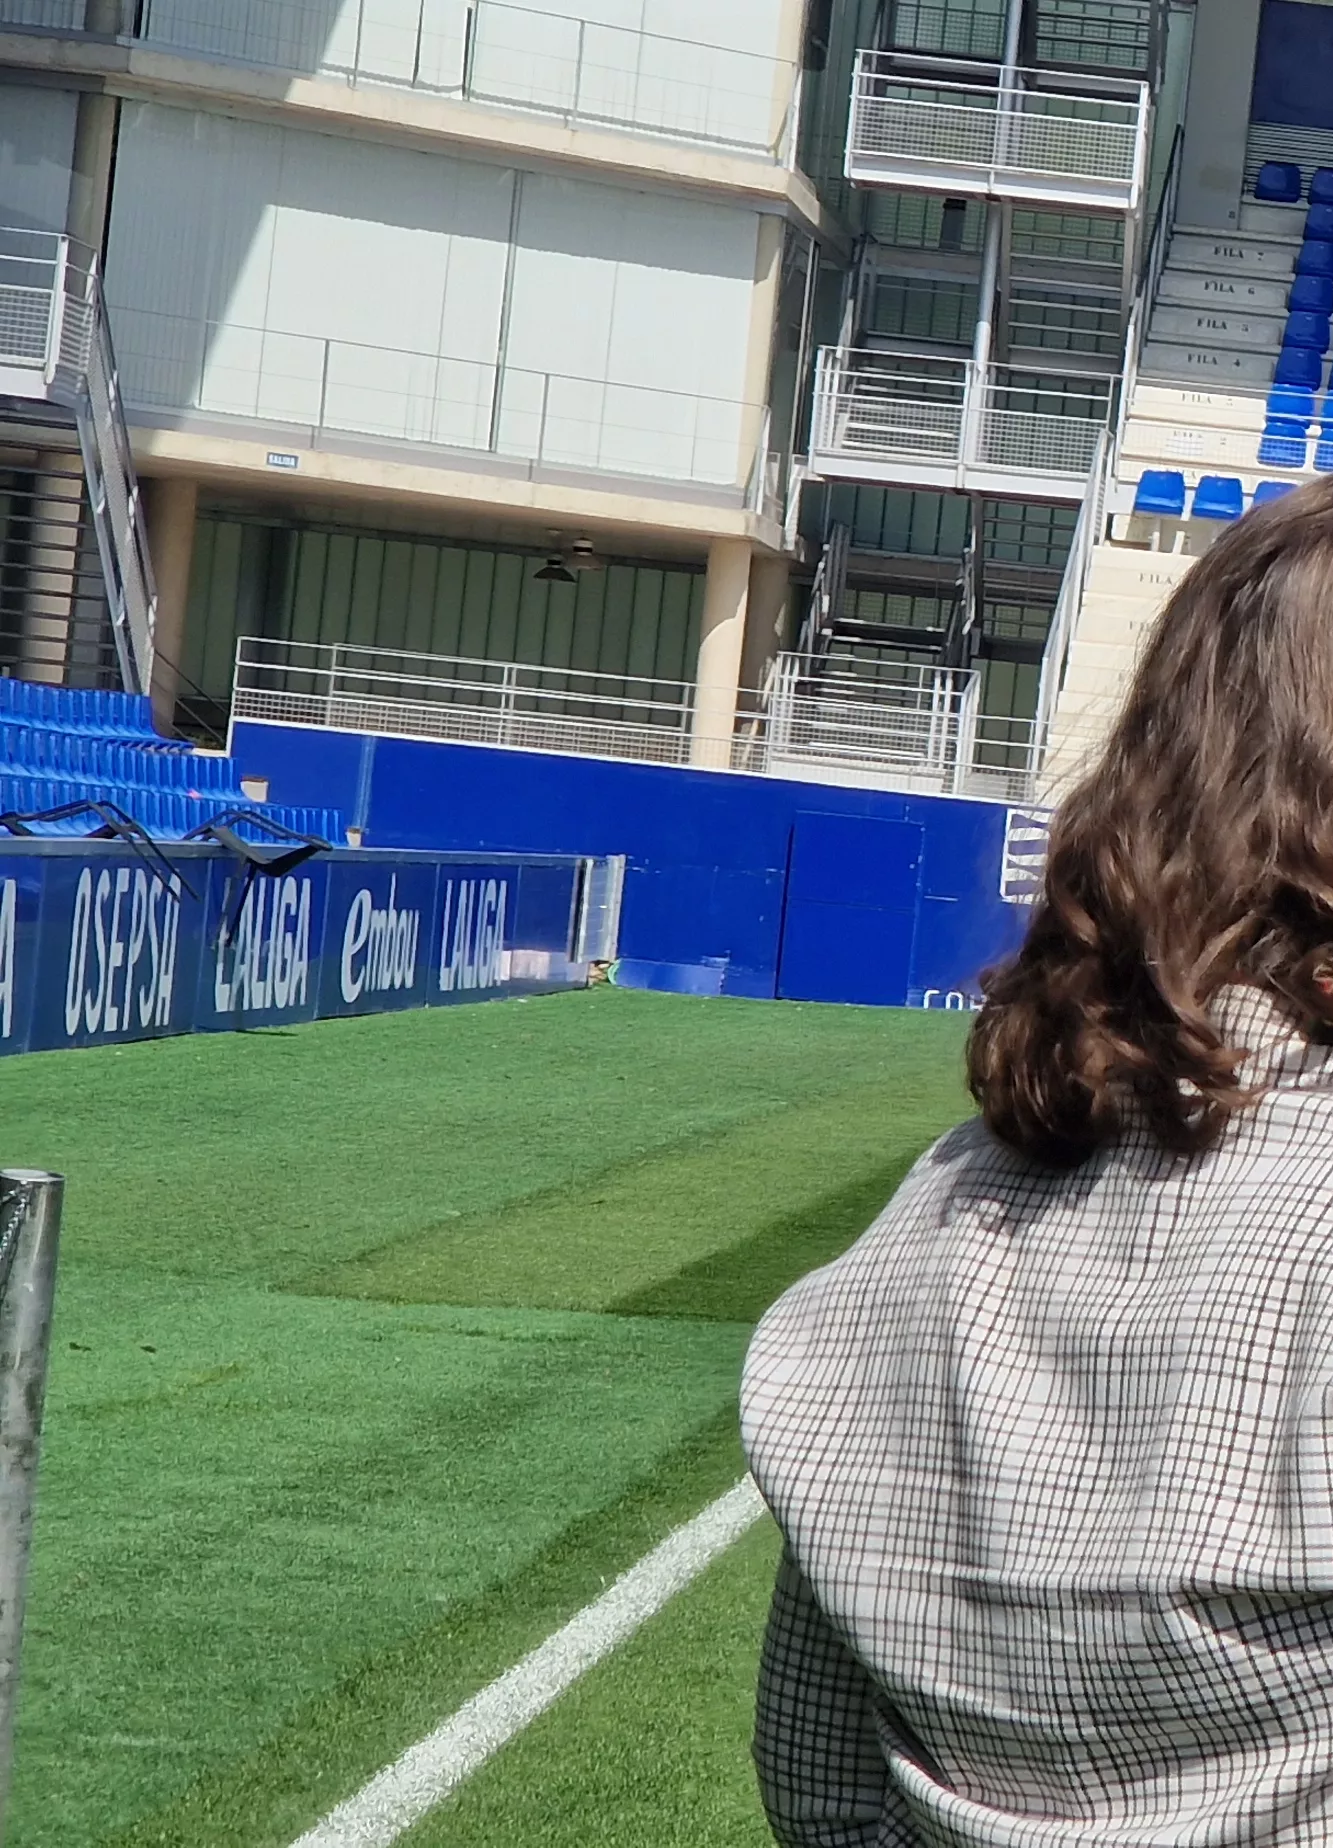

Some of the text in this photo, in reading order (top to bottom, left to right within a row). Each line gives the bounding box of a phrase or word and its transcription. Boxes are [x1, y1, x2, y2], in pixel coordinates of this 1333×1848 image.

[1214, 246, 1244, 259] FILA
[1204, 280, 1255, 295] FILA 6
[1197, 318, 1227, 331] FILA
[1187, 353, 1218, 366] FILA
[1139, 573, 1173, 586] FILA
[341, 873, 419, 1003] embou
[439, 879, 507, 992] LALIGA
[66, 867, 181, 1036] OSEPSA
[214, 876, 311, 1013] LALIGA
